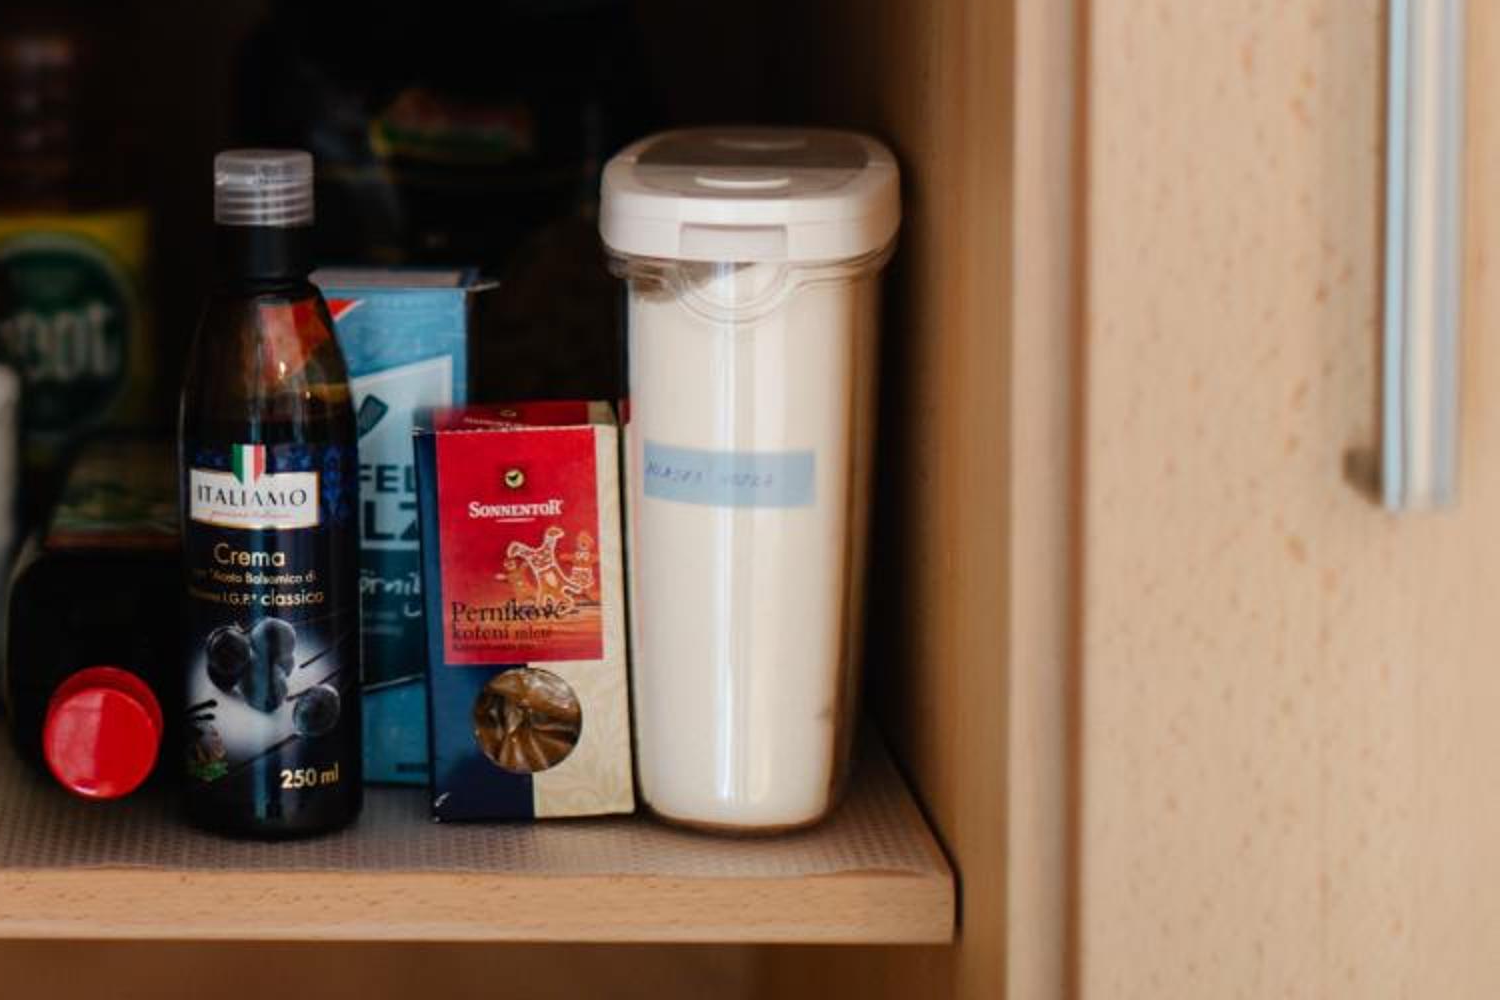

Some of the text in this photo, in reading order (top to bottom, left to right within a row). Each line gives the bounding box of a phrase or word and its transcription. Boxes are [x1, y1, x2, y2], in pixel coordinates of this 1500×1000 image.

[197, 485, 307, 507] ITALIAMO
[213, 542, 286, 567] Crema
[245, 571, 303, 584] Balsamico
[260, 587, 325, 606] classico
[280, 761, 340, 789] 250 ml
